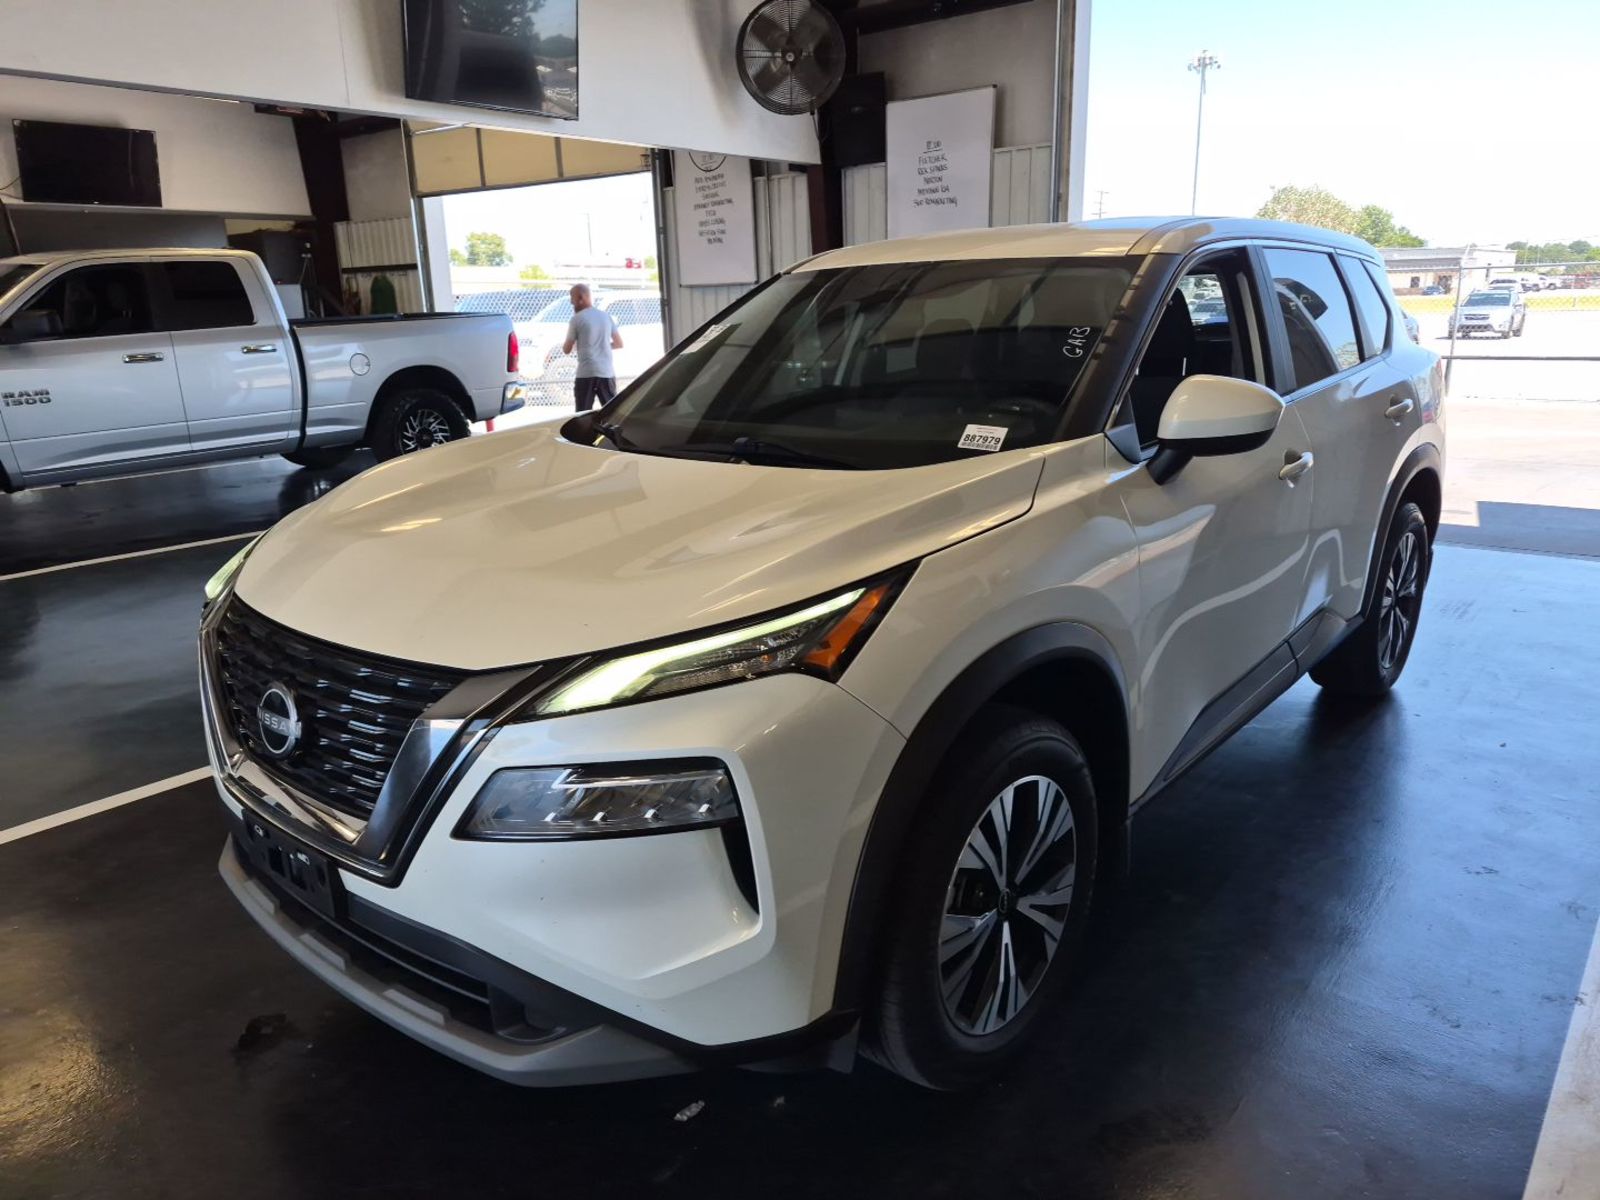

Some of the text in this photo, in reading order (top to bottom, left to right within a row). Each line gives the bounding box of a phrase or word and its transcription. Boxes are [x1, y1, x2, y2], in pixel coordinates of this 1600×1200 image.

[1, 389, 50, 399] RAM
[3, 397, 51, 407] 1500
[963, 433, 1001, 445] 887979
